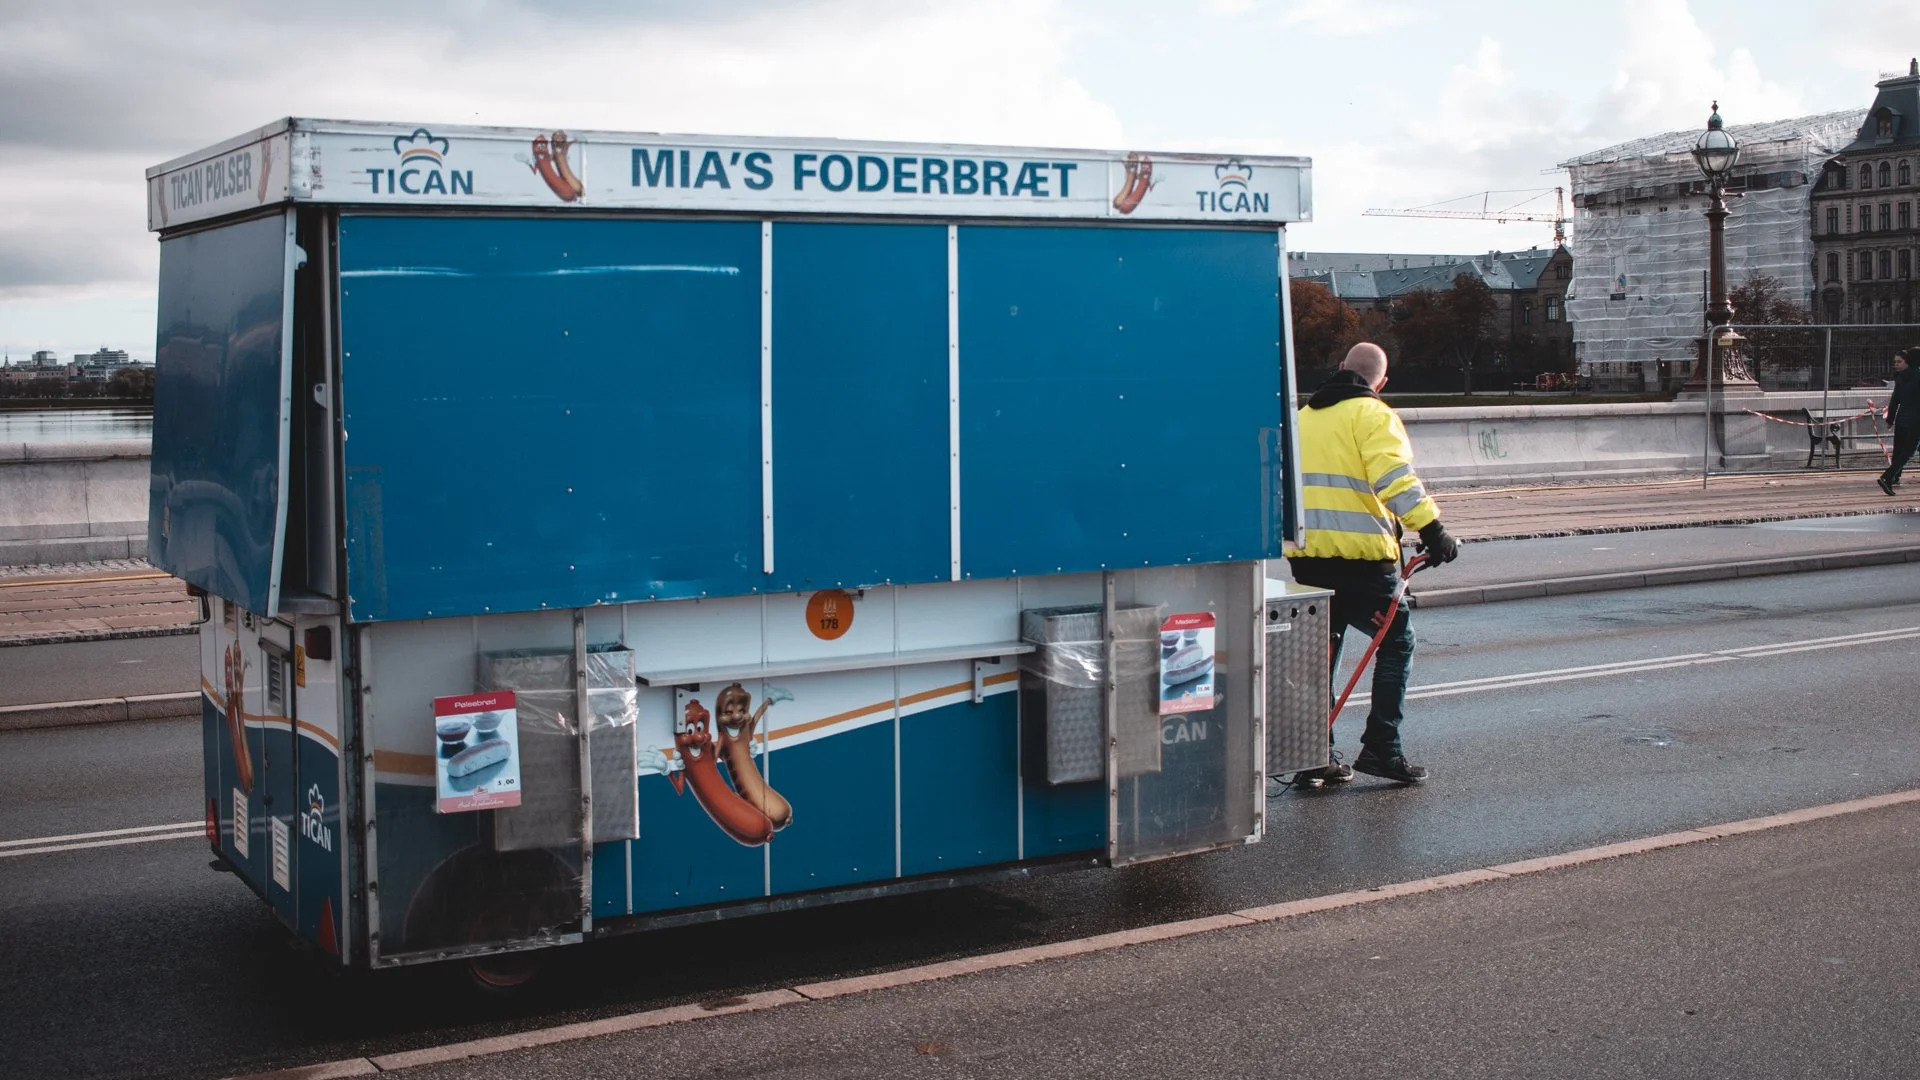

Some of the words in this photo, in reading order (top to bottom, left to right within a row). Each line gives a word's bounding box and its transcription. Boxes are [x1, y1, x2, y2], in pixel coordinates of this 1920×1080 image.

[171, 174, 202, 210] TICAN
[206, 152, 252, 200] PØLSER
[366, 168, 472, 195] TICAN
[631, 148, 774, 191] MIA'S
[793, 153, 1077, 197] FODERBRÆT
[1197, 190, 1272, 213] TICAN
[820, 618, 839, 630] 178
[1160, 721, 1207, 745] CAN
[301, 811, 332, 852] TICAN
